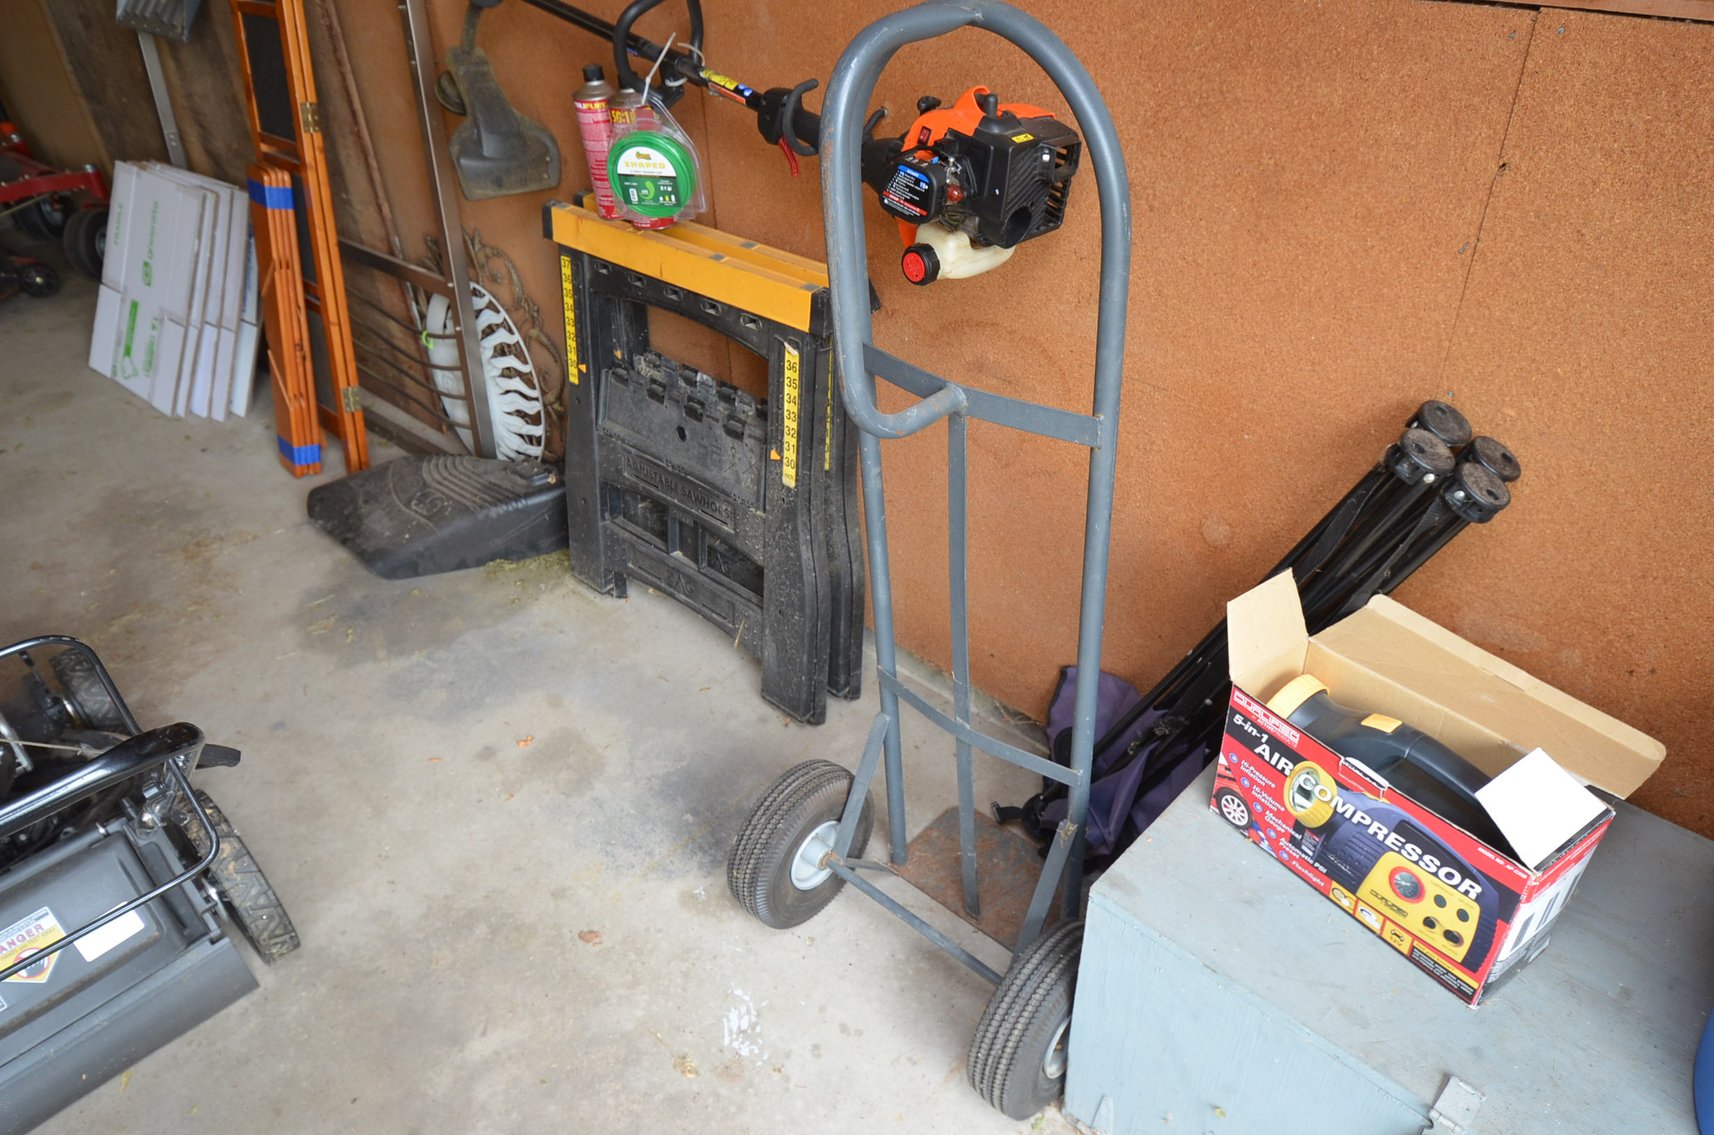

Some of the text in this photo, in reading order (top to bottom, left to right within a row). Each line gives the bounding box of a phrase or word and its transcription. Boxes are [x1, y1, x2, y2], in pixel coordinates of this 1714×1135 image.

[624, 161, 666, 169] SHAPED
[786, 360, 798, 373] 36
[786, 377, 798, 390] 35
[786, 393, 797, 407] 34
[785, 409, 797, 422] 33
[785, 426, 796, 439] 32
[785, 442, 795, 454] 31
[784, 457, 795, 469] 30
[681, 486, 735, 520] SAWHORS
[1233, 690, 1300, 745] QUALIFIED
[1233, 714, 1269, 743] 5-in-1
[1240, 765, 1266, 787] Inflation
[1241, 760, 1276, 789] Hi-Pressure
[1252, 790, 1278, 811] Inflation
[1253, 785, 1286, 812] Hi-Volume
[1254, 744, 1294, 776] AIR
[1299, 774, 1483, 901] COMPRESSOR
[1264, 815, 1286, 834] Gauge
[1265, 810, 1302, 840] Mechanical
[1279, 841, 1300, 859] Preset
[1280, 837, 1314, 865] Automatic
[1314, 862, 1327, 873] PSI
[1292, 860, 1325, 887] Flashlight
[0, 924, 44, 953] ANGER
